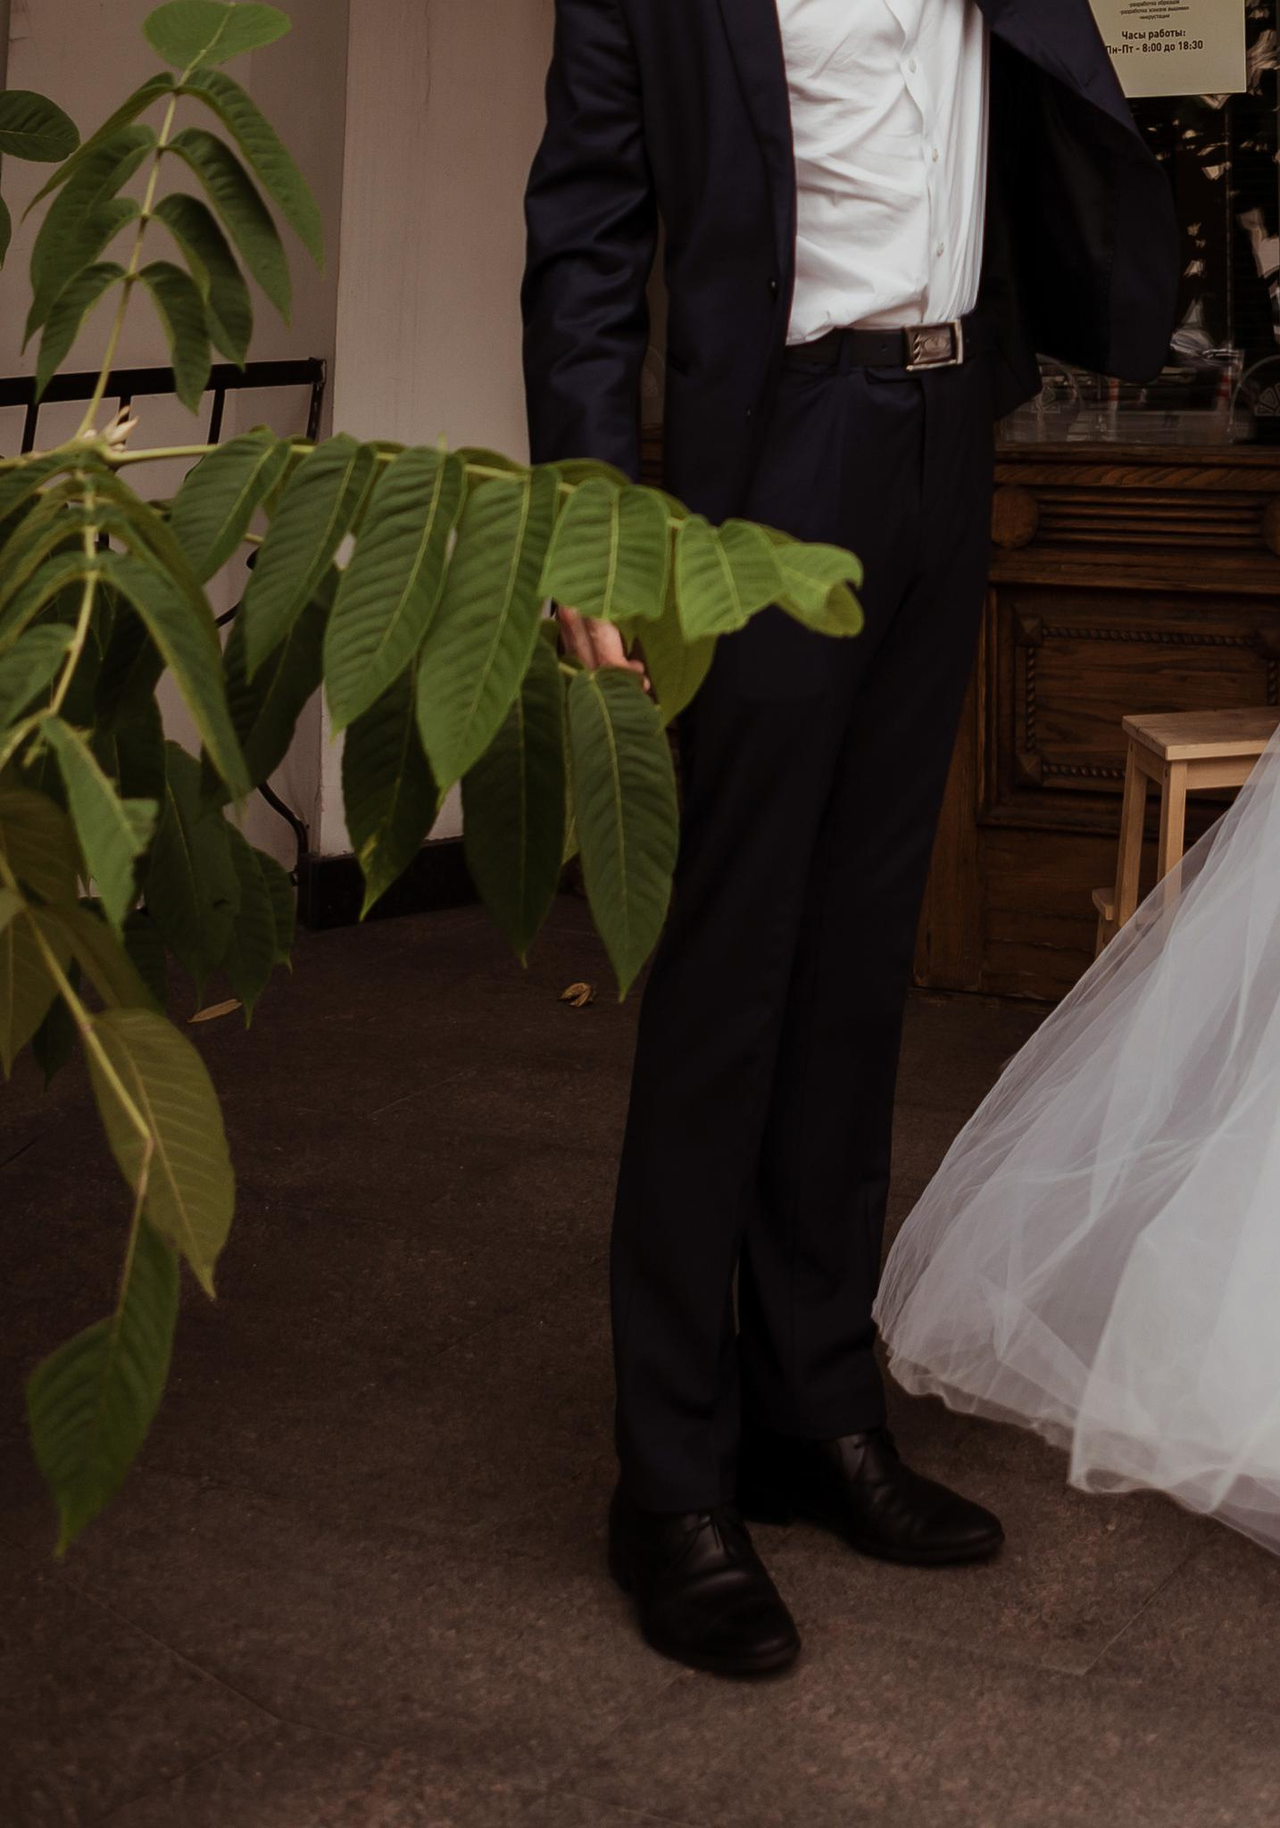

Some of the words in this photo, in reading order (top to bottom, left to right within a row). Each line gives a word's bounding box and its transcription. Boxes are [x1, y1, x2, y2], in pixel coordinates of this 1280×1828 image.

[1121, 31, 1146, 40] Часы
[1148, 29, 1186, 40] работы:
[1105, 44, 1133, 54] Пн-Пт
[1142, 43, 1162, 53] 8:00
[1164, 44, 1176, 53] до
[1178, 40, 1203, 50] 18:30
